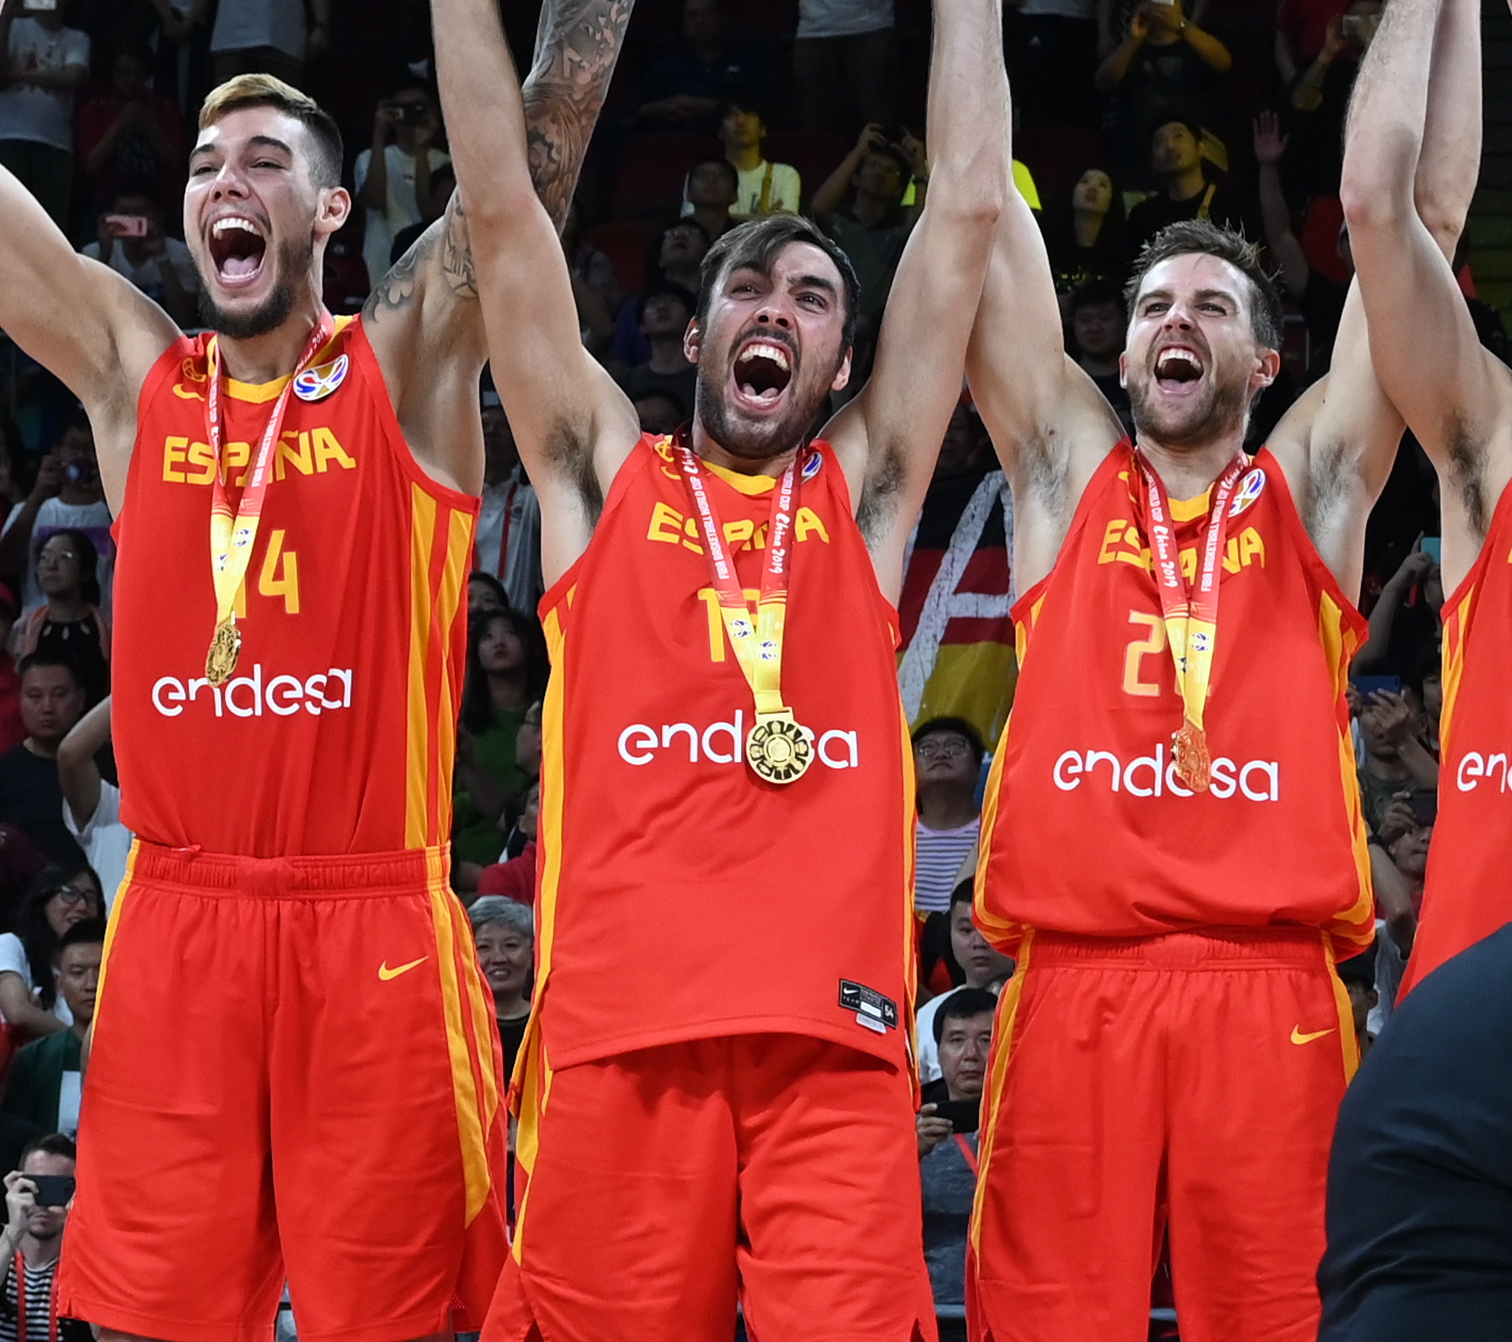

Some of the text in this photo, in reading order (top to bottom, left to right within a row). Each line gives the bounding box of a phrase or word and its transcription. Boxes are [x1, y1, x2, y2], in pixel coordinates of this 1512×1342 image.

[774, 512, 791, 548] China
[768, 548, 786, 574] 2019
[1153, 525, 1169, 559] China
[1161, 561, 1178, 587] 2019
[1200, 574, 1211, 592] FIBA
[152, 664, 352, 718] endesa
